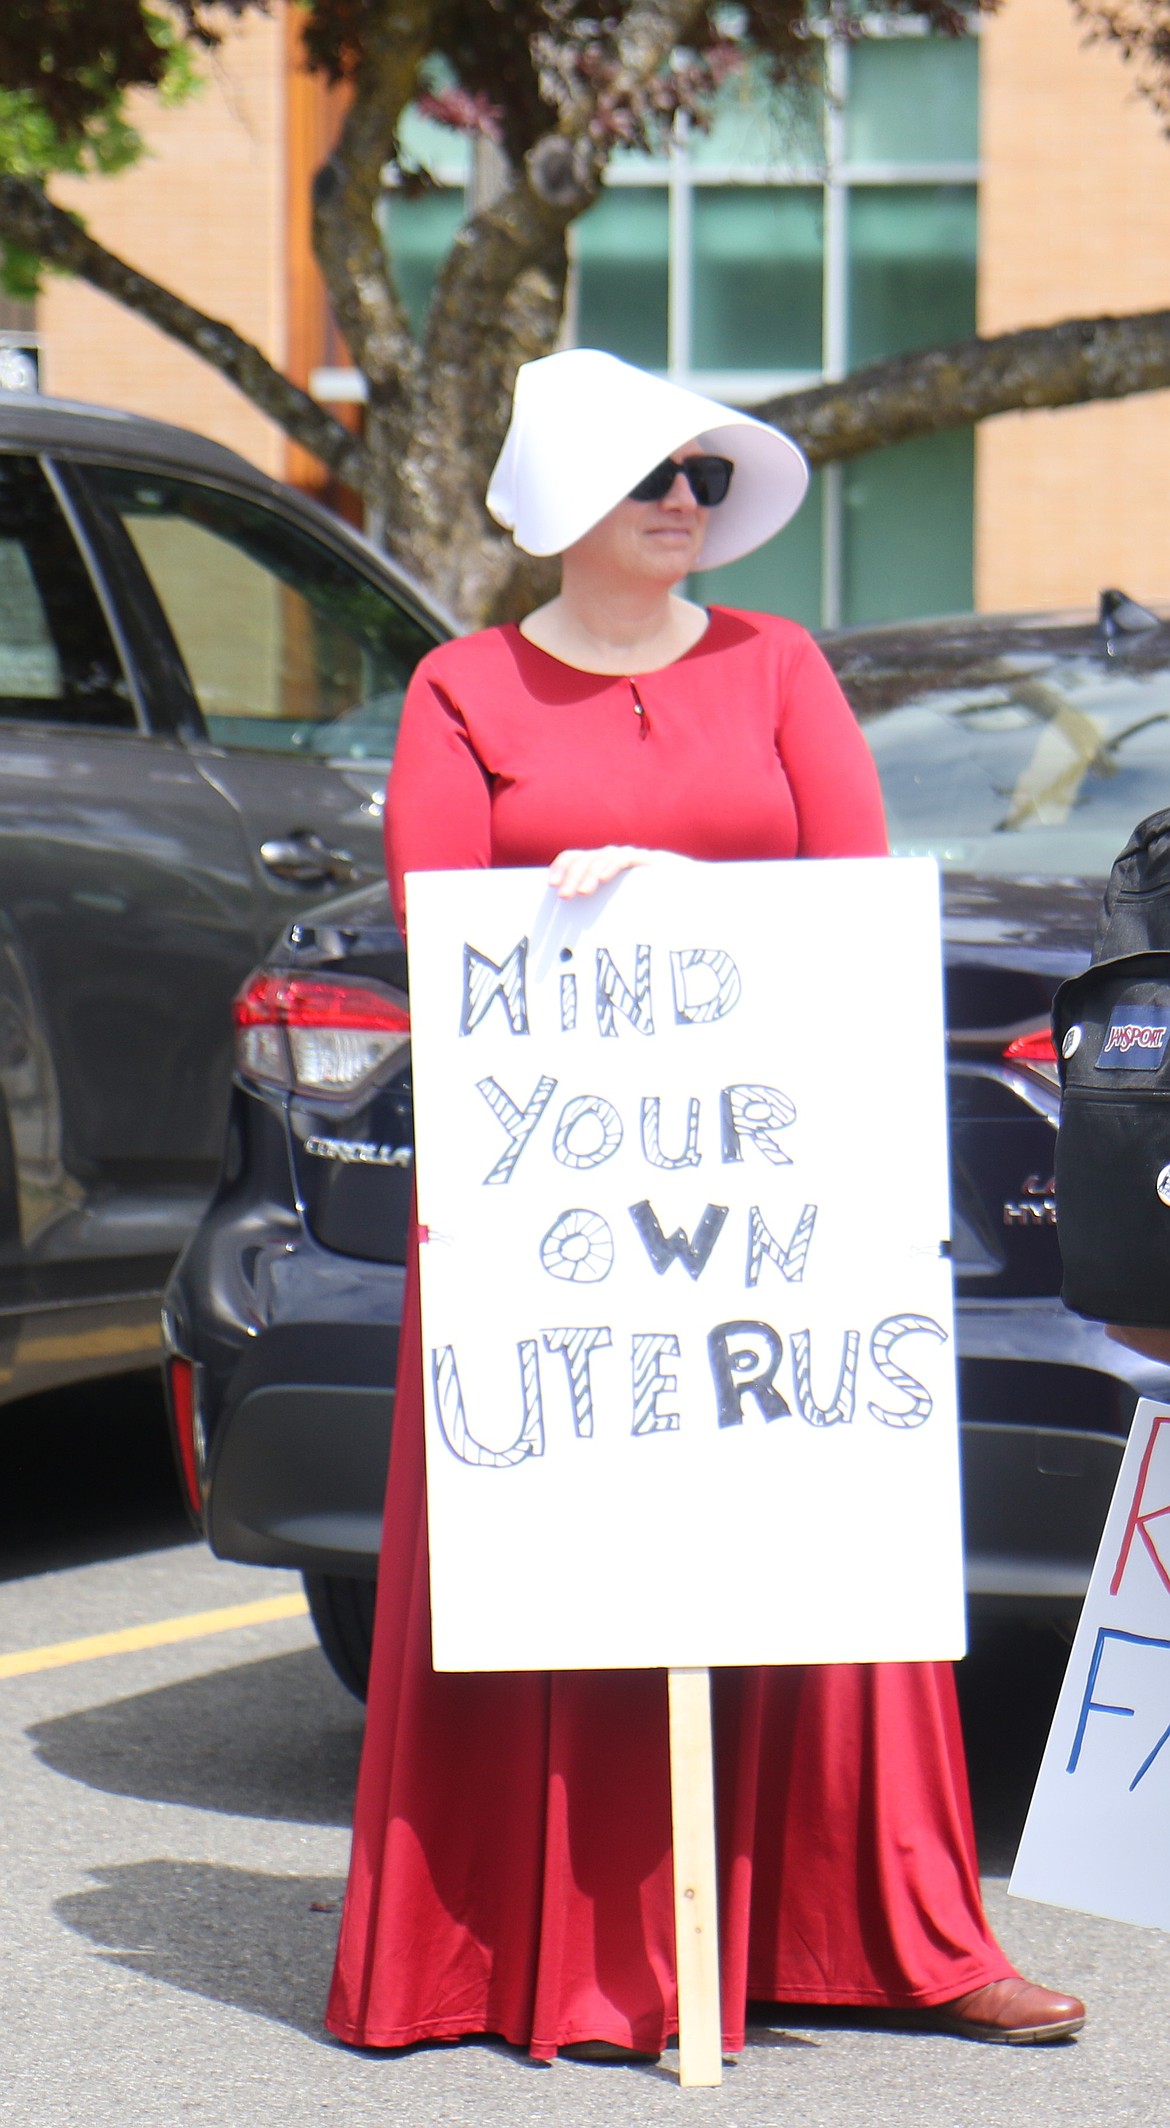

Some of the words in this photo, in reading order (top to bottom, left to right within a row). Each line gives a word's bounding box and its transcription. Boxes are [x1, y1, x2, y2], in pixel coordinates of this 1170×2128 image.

[477, 1075, 797, 1185] YOUR
[541, 1200, 818, 1287] OWN
[432, 1313, 949, 1468] UTERUS
